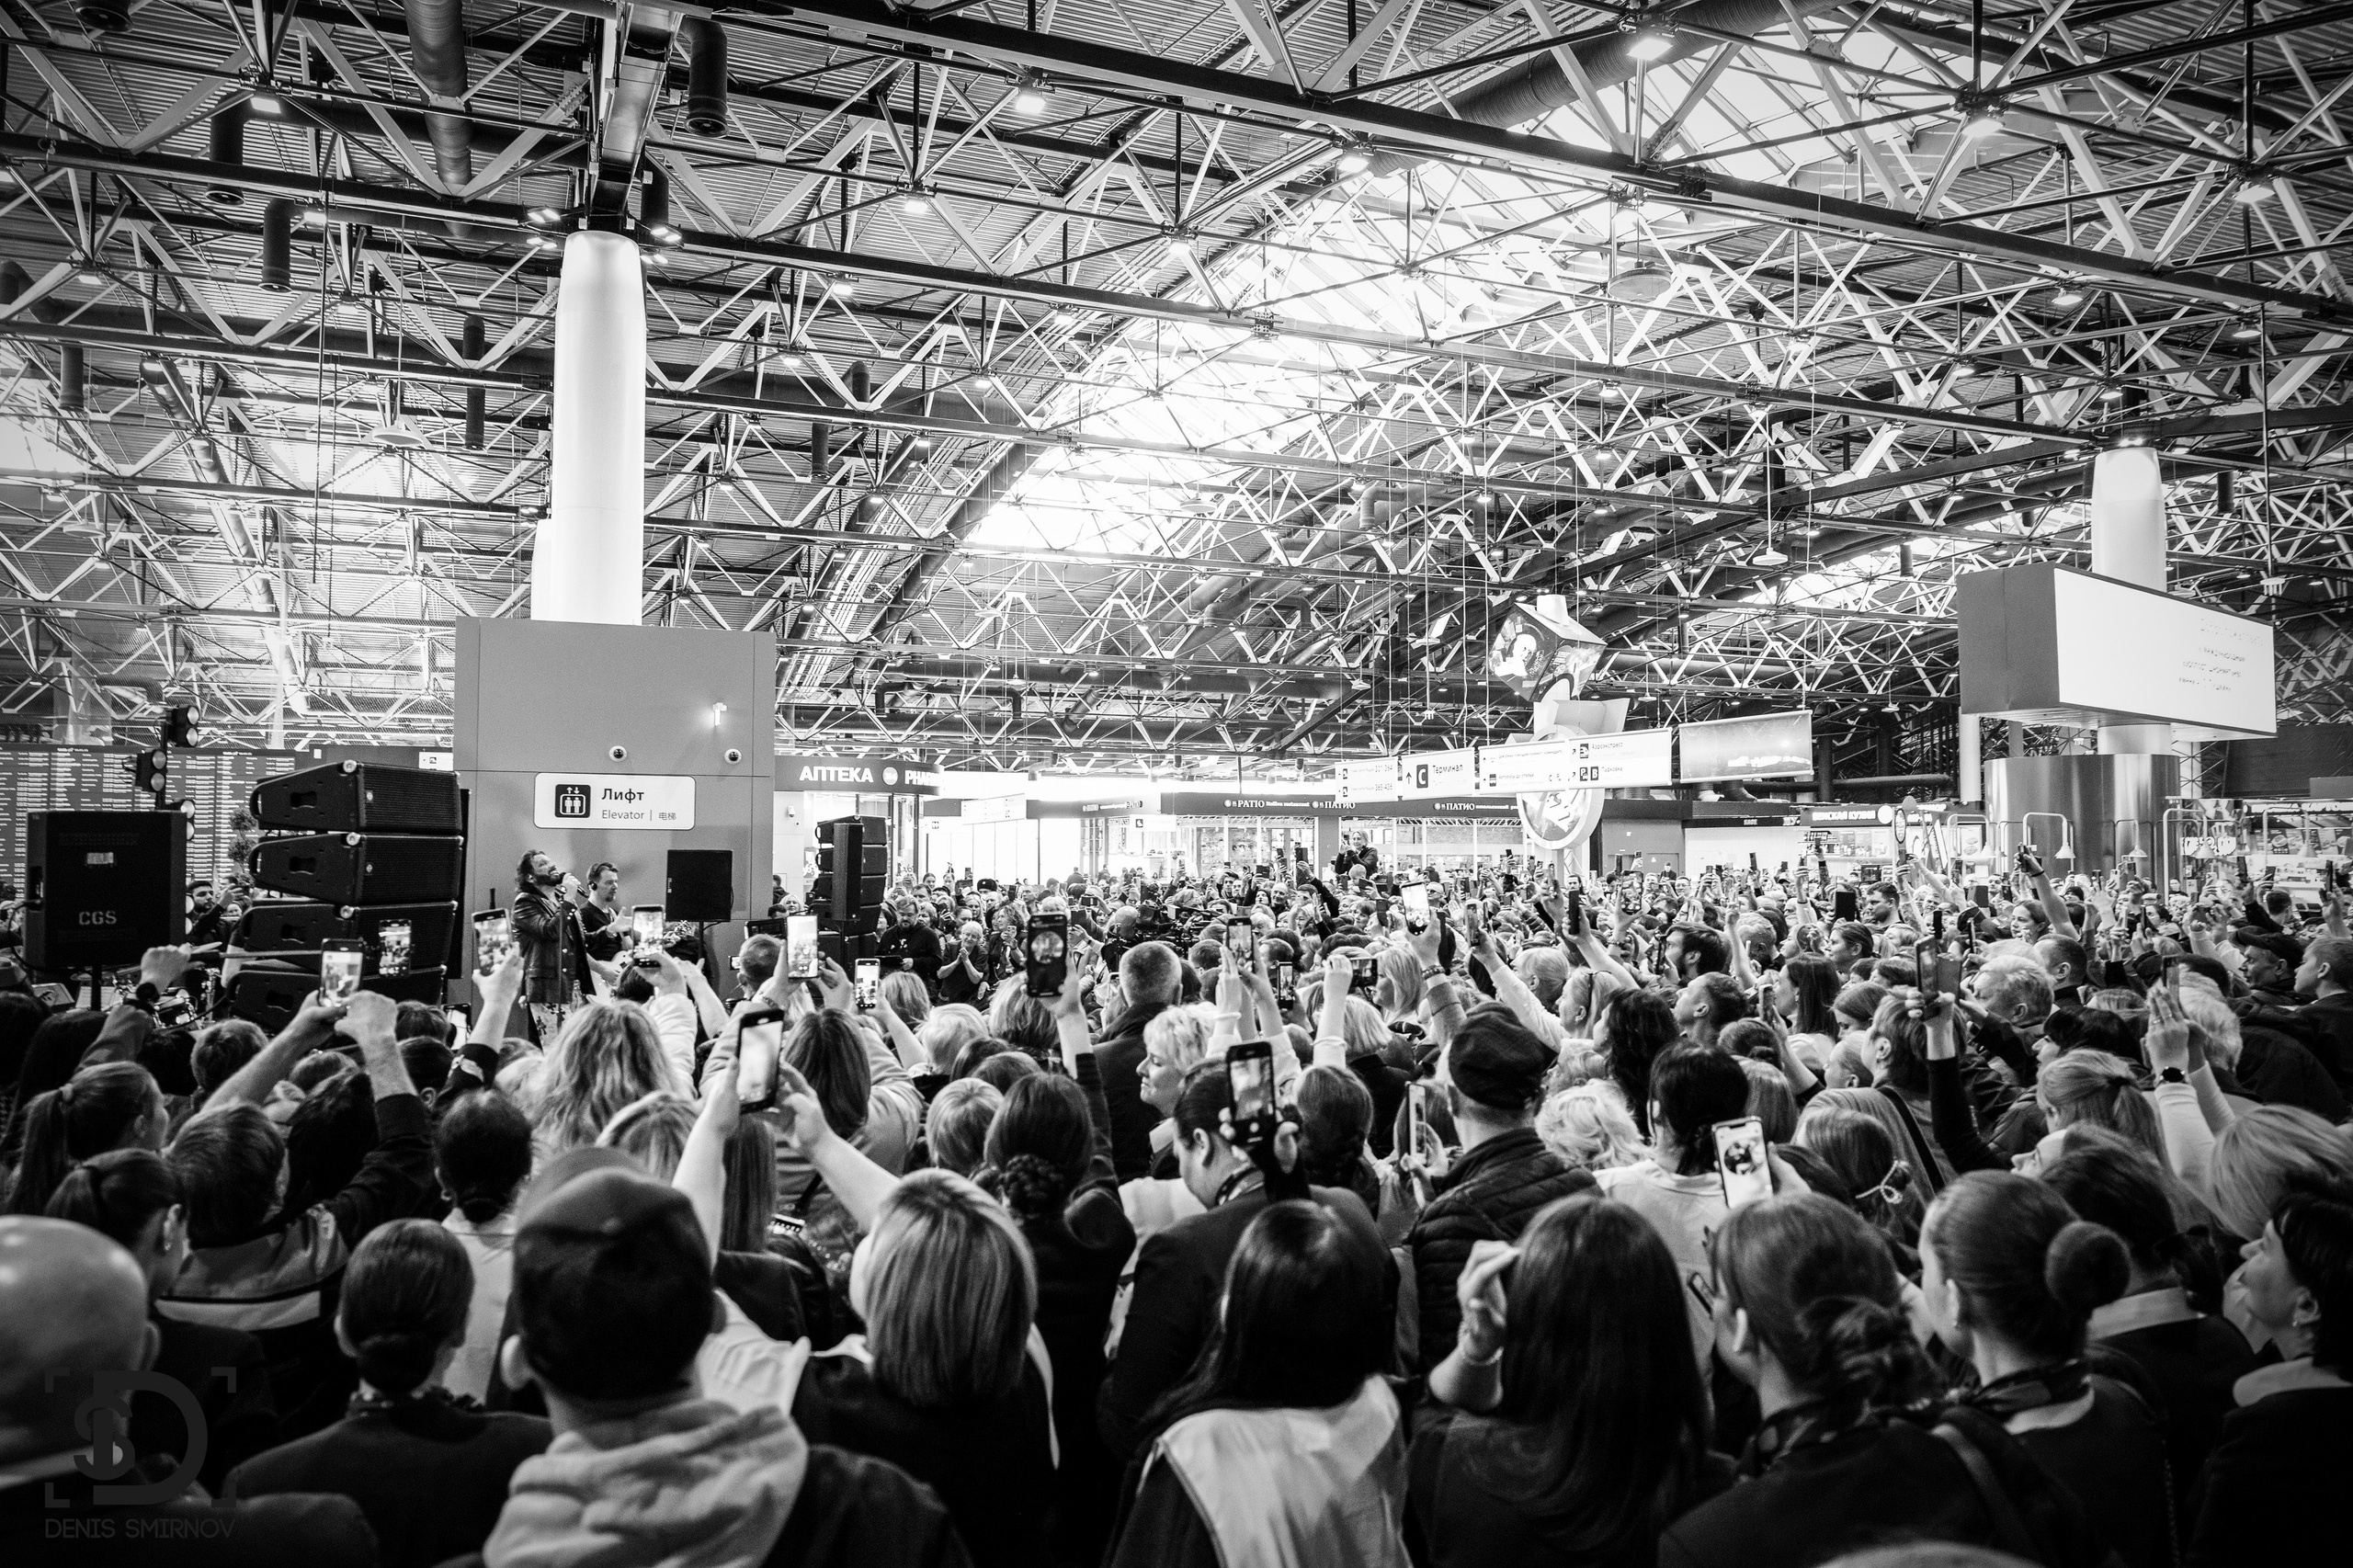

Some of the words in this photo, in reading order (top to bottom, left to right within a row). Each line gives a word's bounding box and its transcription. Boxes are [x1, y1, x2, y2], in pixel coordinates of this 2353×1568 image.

[799, 766, 873, 782] АПТЕКА
[1432, 764, 1463, 776] Терминал
[601, 789, 644, 803] Лифт
[1237, 800, 1265, 808] PATIO
[1324, 801, 1356, 809] ПАТИО
[1446, 802, 1475, 811] ПАТИО
[601, 809, 644, 820] Elevator
[658, 812, 676, 821] 电梯
[78, 910, 118, 926] CGS
